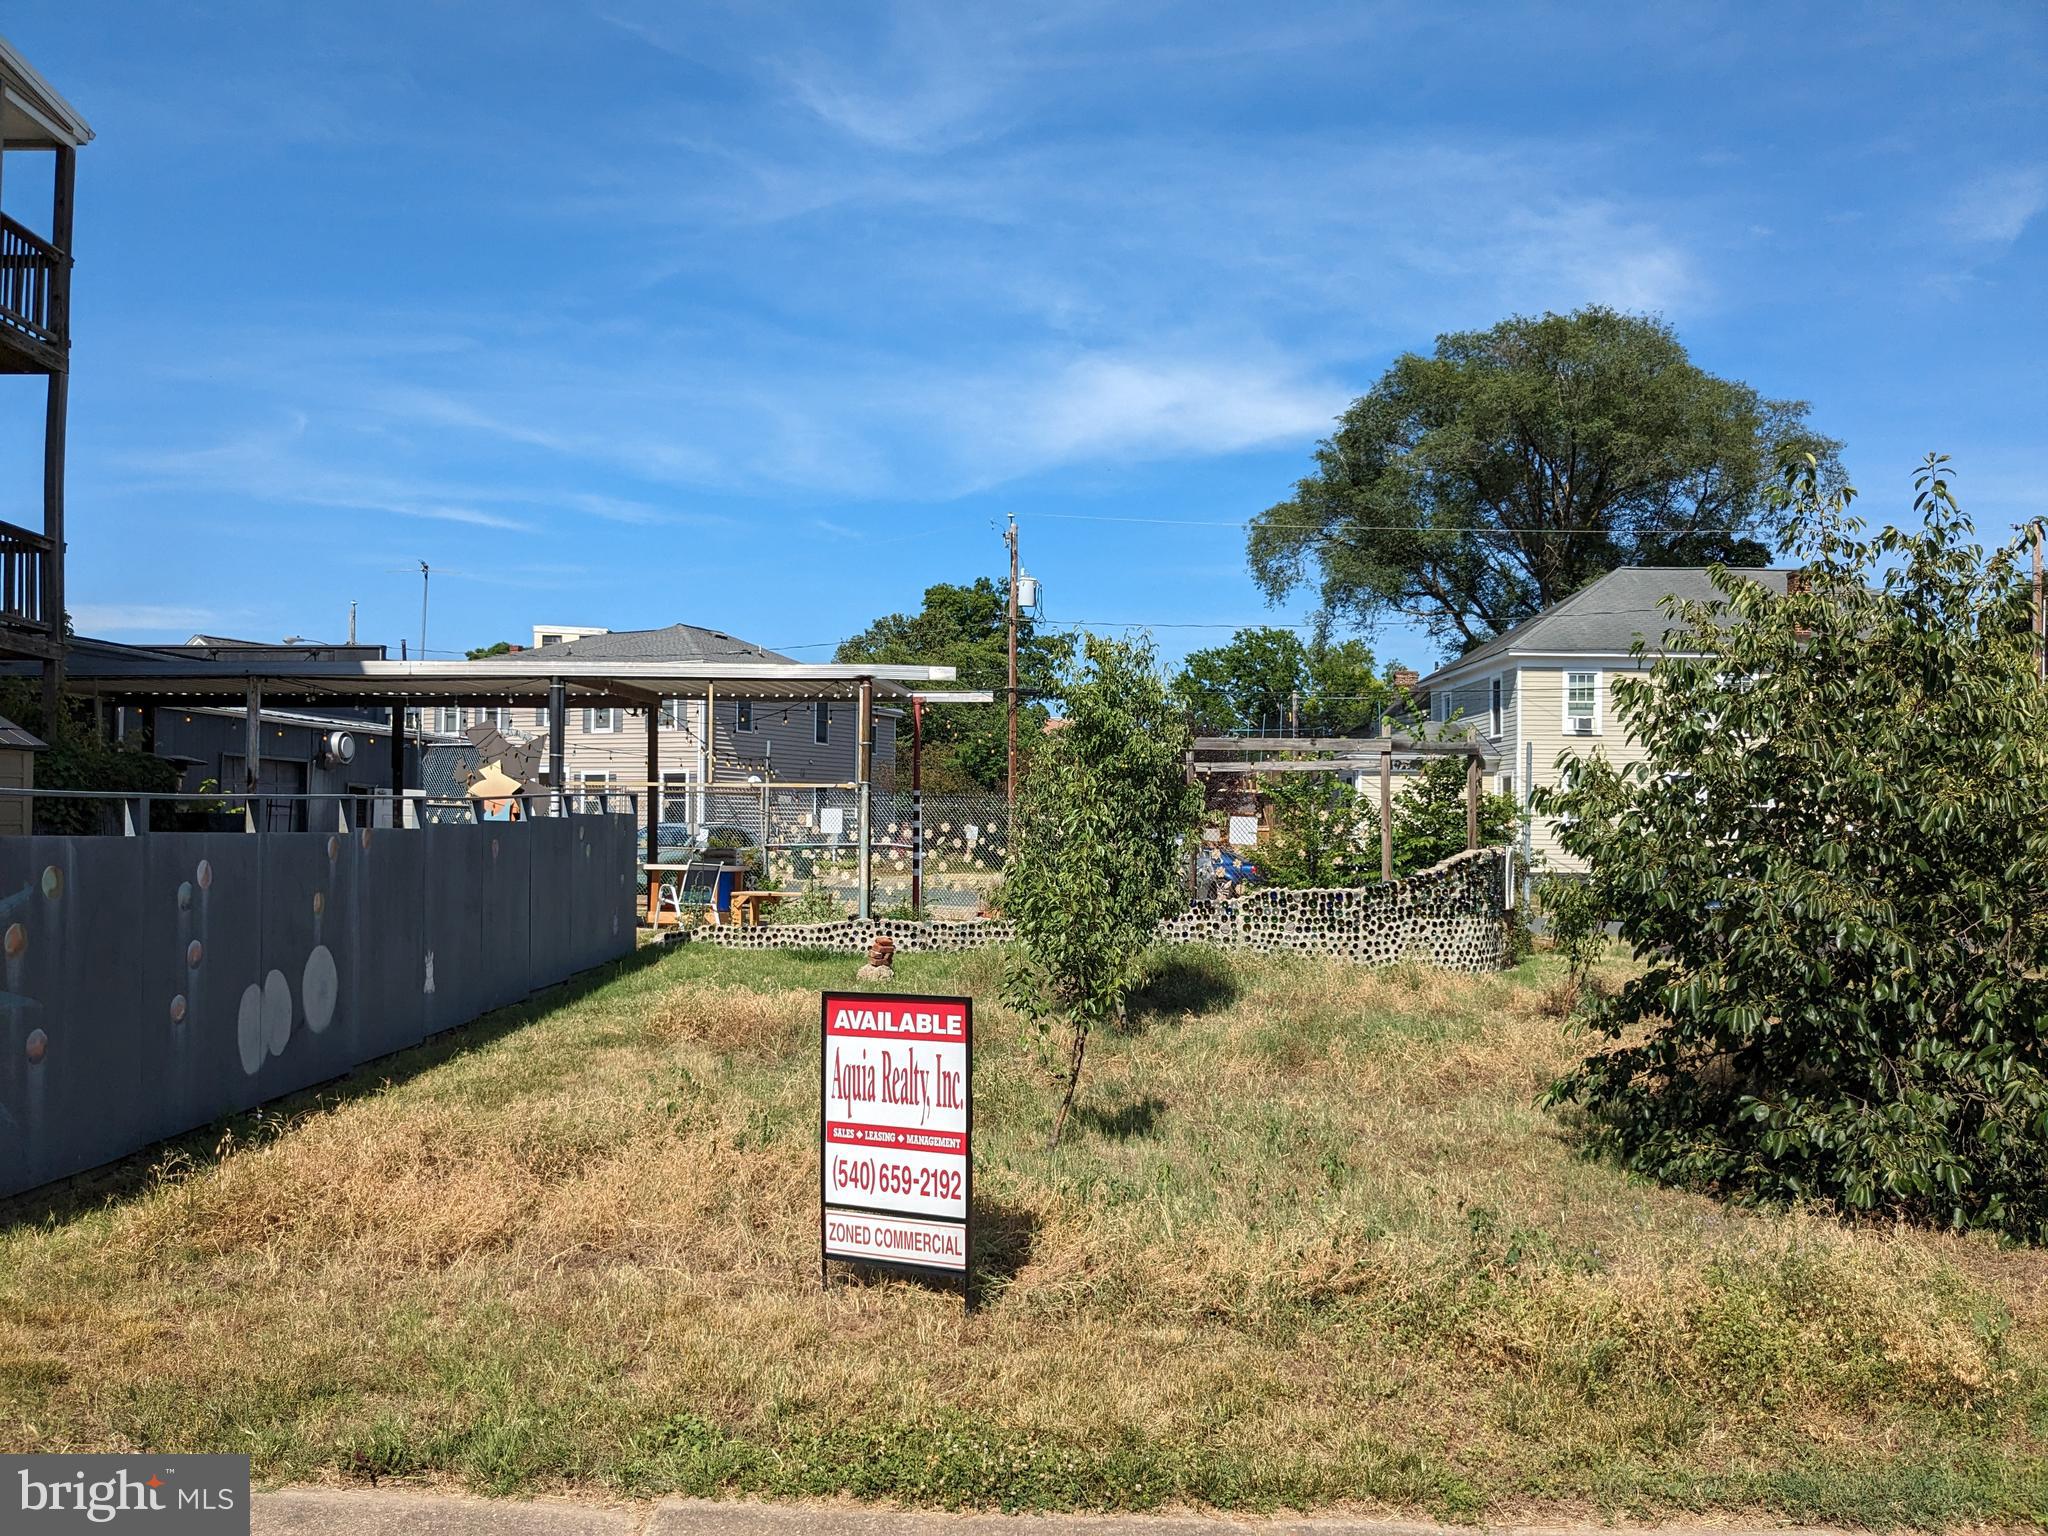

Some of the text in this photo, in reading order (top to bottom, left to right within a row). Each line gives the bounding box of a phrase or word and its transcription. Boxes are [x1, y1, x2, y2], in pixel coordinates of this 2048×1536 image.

[833, 1009, 962, 1036] AVAILABLE
[831, 1046, 963, 1126] Aquia Realty, Inc.
[833, 1127, 962, 1149] SALES LEASING MANAGEMENT
[832, 1154, 962, 1201] (540) 659-2192
[829, 1222, 963, 1257] ZONED COMMERCIAL
